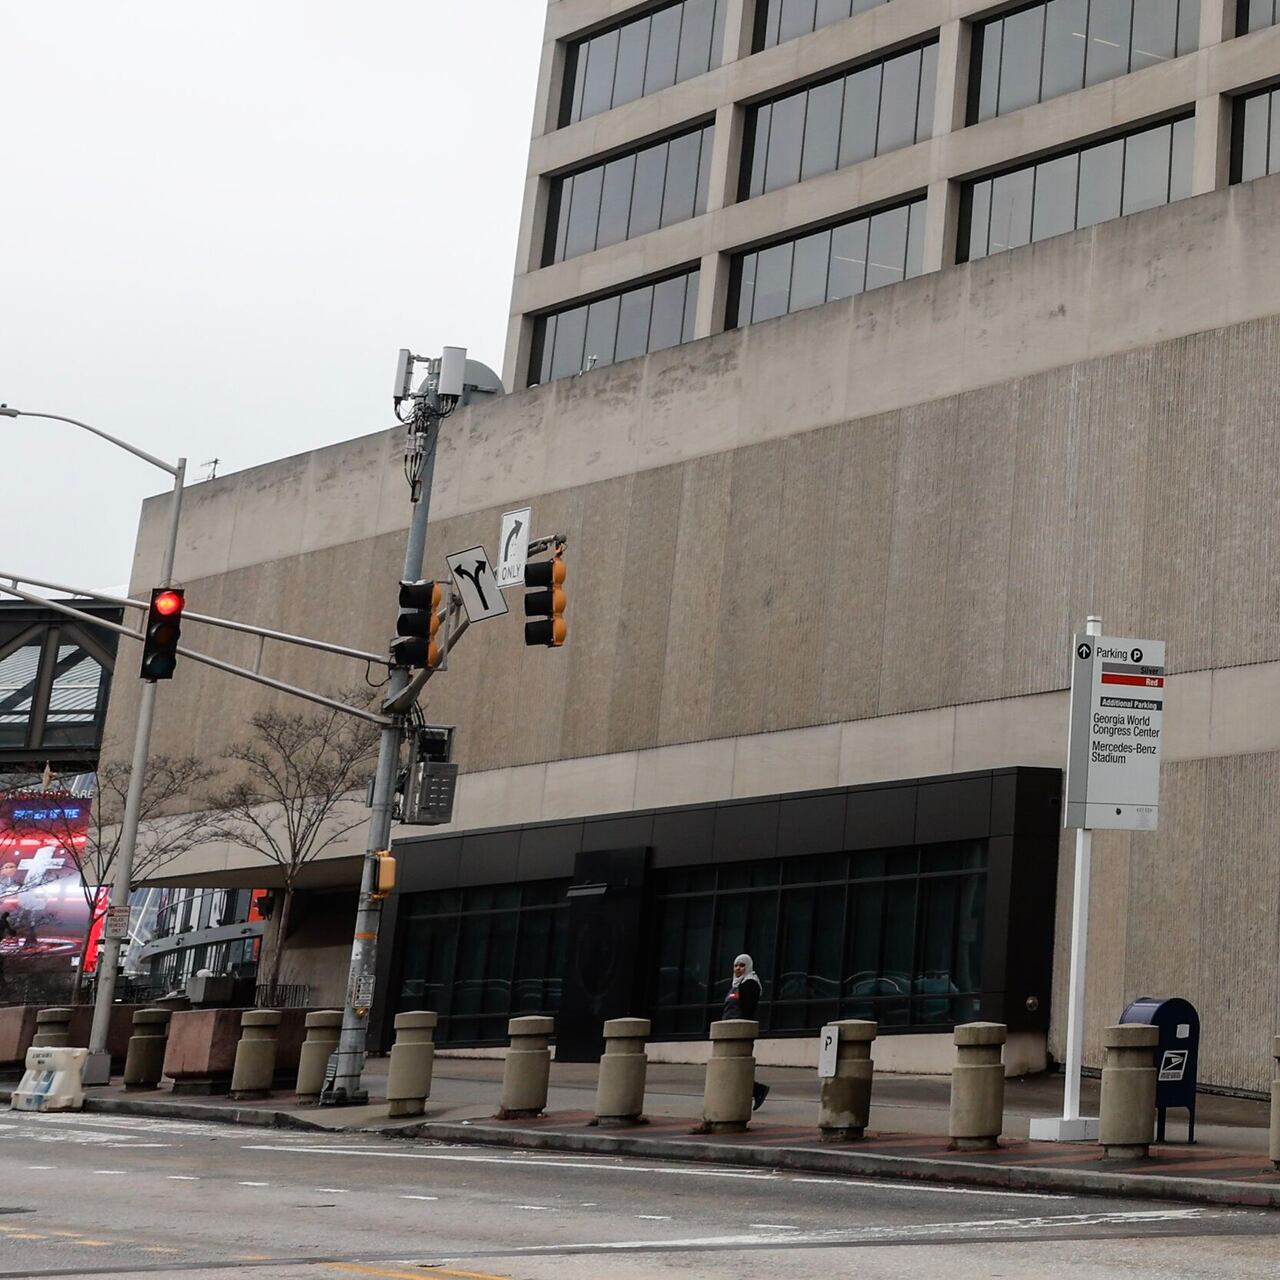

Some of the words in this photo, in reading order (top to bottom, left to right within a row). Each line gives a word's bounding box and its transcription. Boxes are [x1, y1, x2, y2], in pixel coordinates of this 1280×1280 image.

[502, 563, 521, 580] ONLY
[1096, 647, 1128, 661] Parking
[1140, 666, 1159, 675] Silver
[1145, 678, 1159, 687] Red
[1102, 698, 1133, 708] Additional
[1134, 700, 1157, 710] Parking
[1094, 712, 1125, 726] Georgia
[1127, 714, 1150, 726] World
[1093, 723, 1131, 737] Congress
[1133, 726, 1160, 738] Center
[1092, 740, 1157, 754] Mercedes-Benz
[1091, 751, 1126, 763] Stadium
